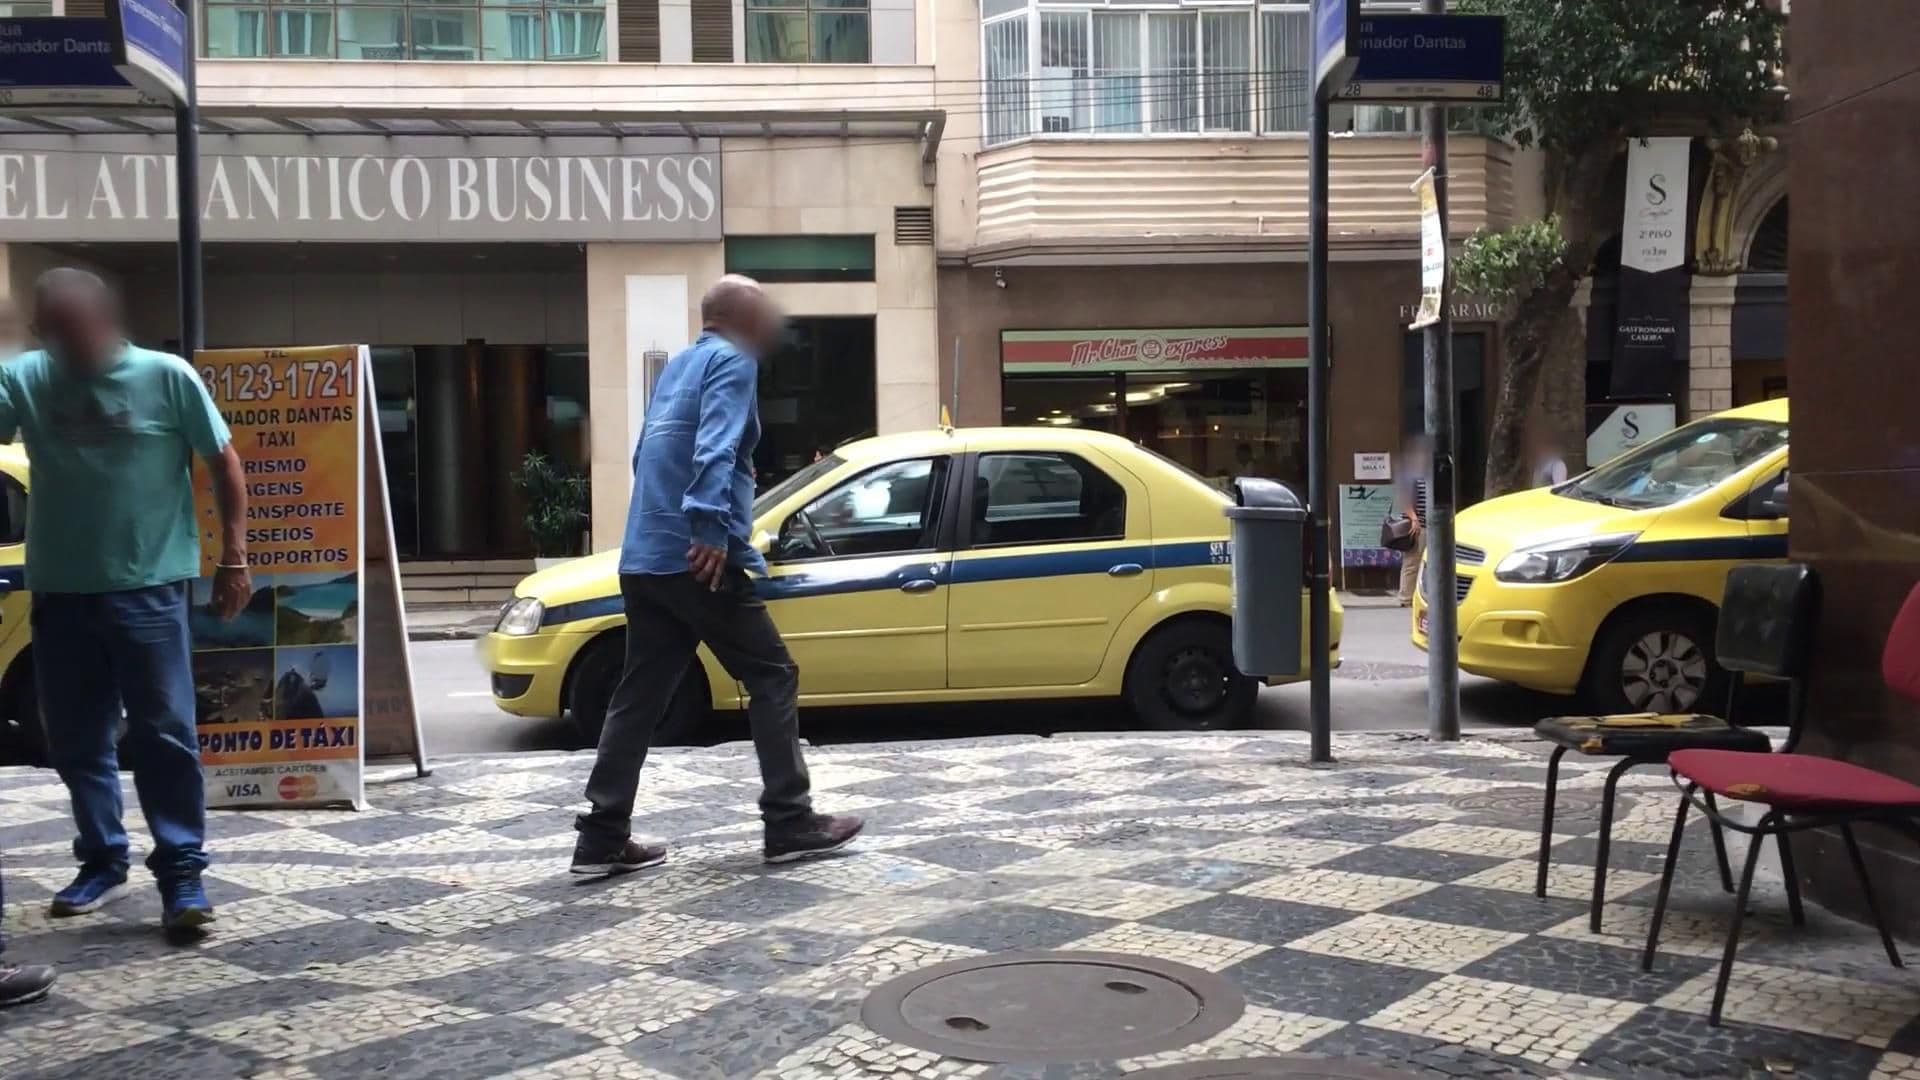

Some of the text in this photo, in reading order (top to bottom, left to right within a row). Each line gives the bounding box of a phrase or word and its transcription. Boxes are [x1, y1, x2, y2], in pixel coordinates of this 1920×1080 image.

[0, 38, 113, 53] enador Danta
[1359, 34, 1467, 49] nador Dantas
[1477, 85, 1493, 97] 48
[447, 155, 715, 222] BUSINESS
[1618, 325, 1676, 334] GASTRONOMIA
[221, 406, 354, 426] NADOR DANTAS
[256, 431, 296, 448] TAXI
[244, 458, 306, 474] RISMO
[247, 502, 345, 520] ANSPORTE
[246, 526, 314, 543] SSEIOS
[247, 548, 349, 566] ROPORTOS
[198, 730, 263, 753] PONTO
[269, 728, 297, 749] DE
[225, 783, 262, 797] VISA
